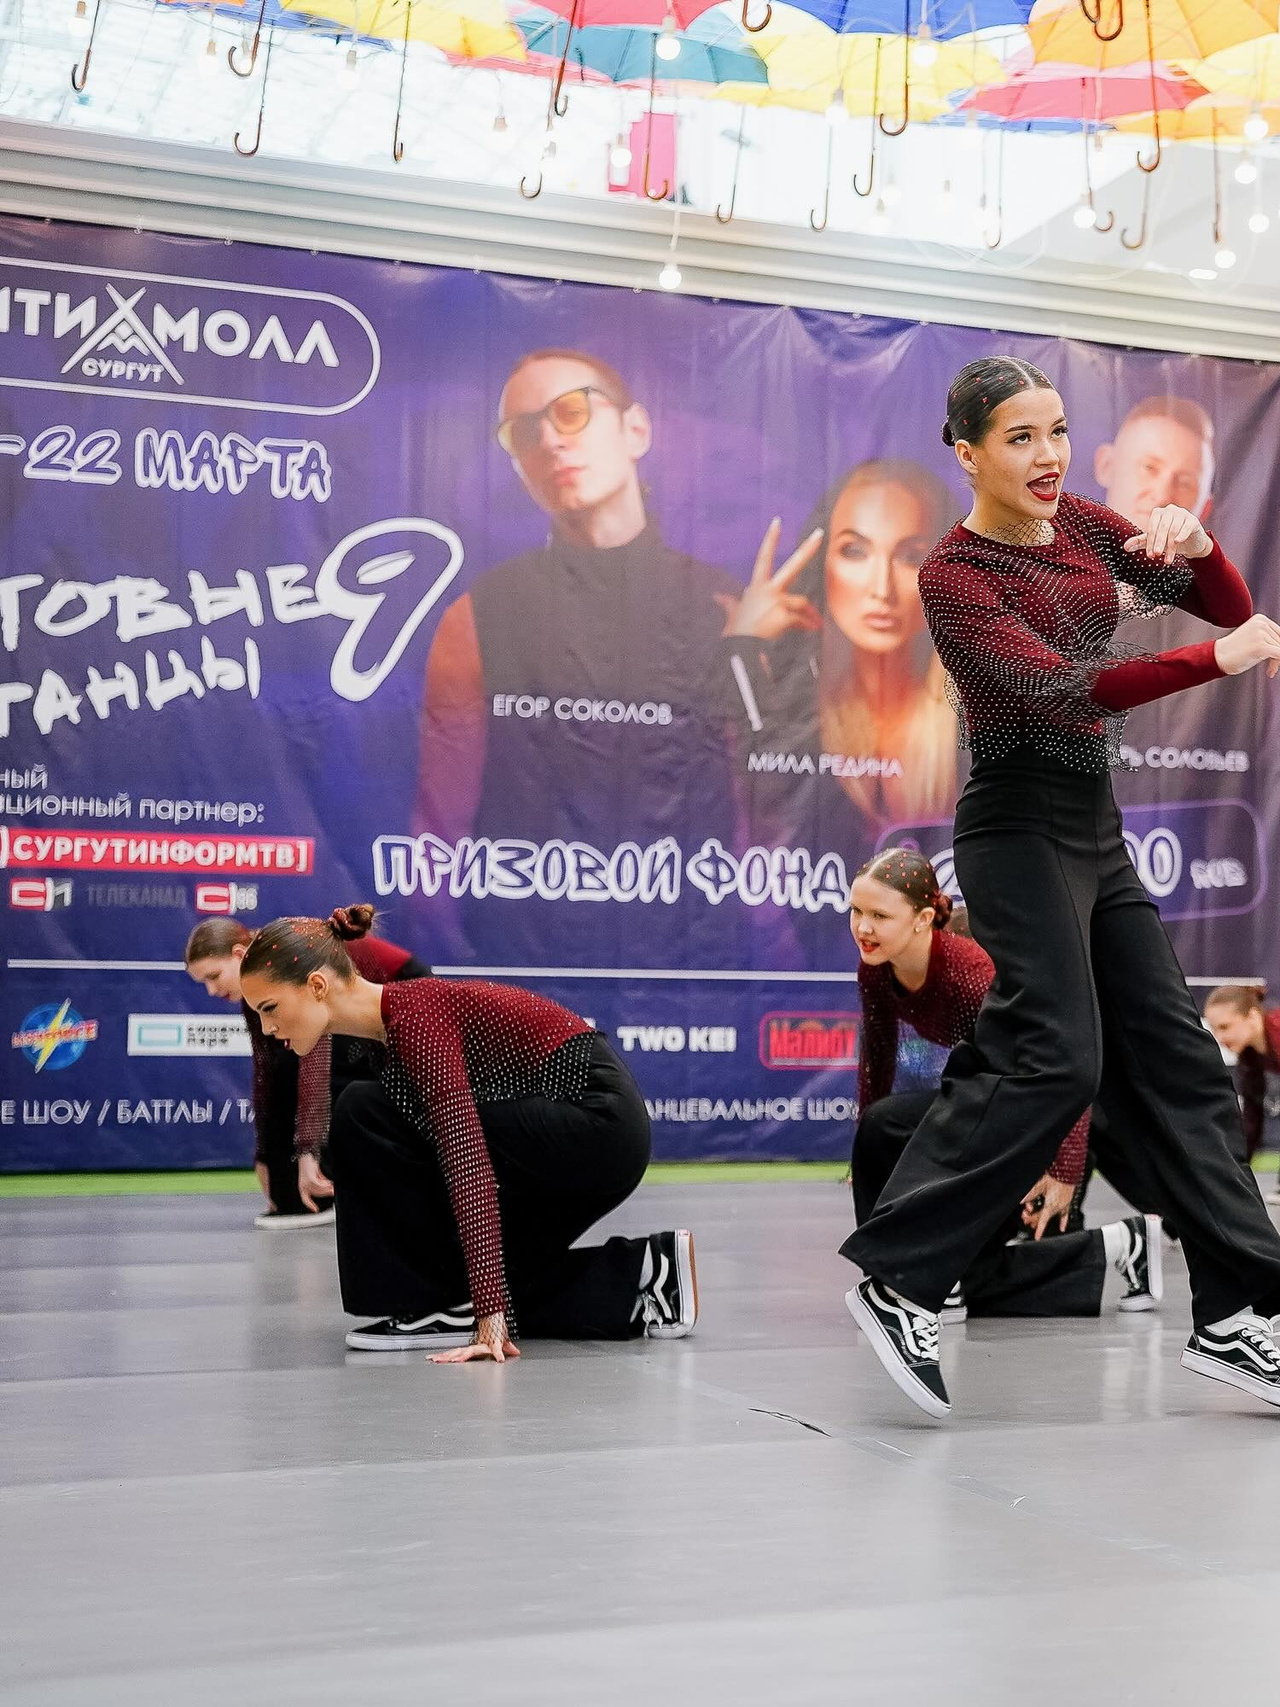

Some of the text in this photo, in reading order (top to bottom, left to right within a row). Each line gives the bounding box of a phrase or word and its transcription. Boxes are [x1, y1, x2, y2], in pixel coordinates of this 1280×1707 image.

[0, 286, 339, 368] ТИ МОЛЛ
[81, 357, 165, 383] СУРГУТ
[135, 427, 332, 502] МАРТА
[493, 694, 672, 725] ЕГОР СОКОЛОВ
[747, 752, 904, 778] МИЛА РЕДИНА
[0, 792, 132, 818] ционный
[371, 832, 682, 904] ПРИЗОВОЙ
[686, 838, 851, 914] ФОНД
[617, 1025, 685, 1052] TWO
[23, 1099, 91, 1125] ШОУ
[117, 1099, 212, 1124] БАТТЛЫ
